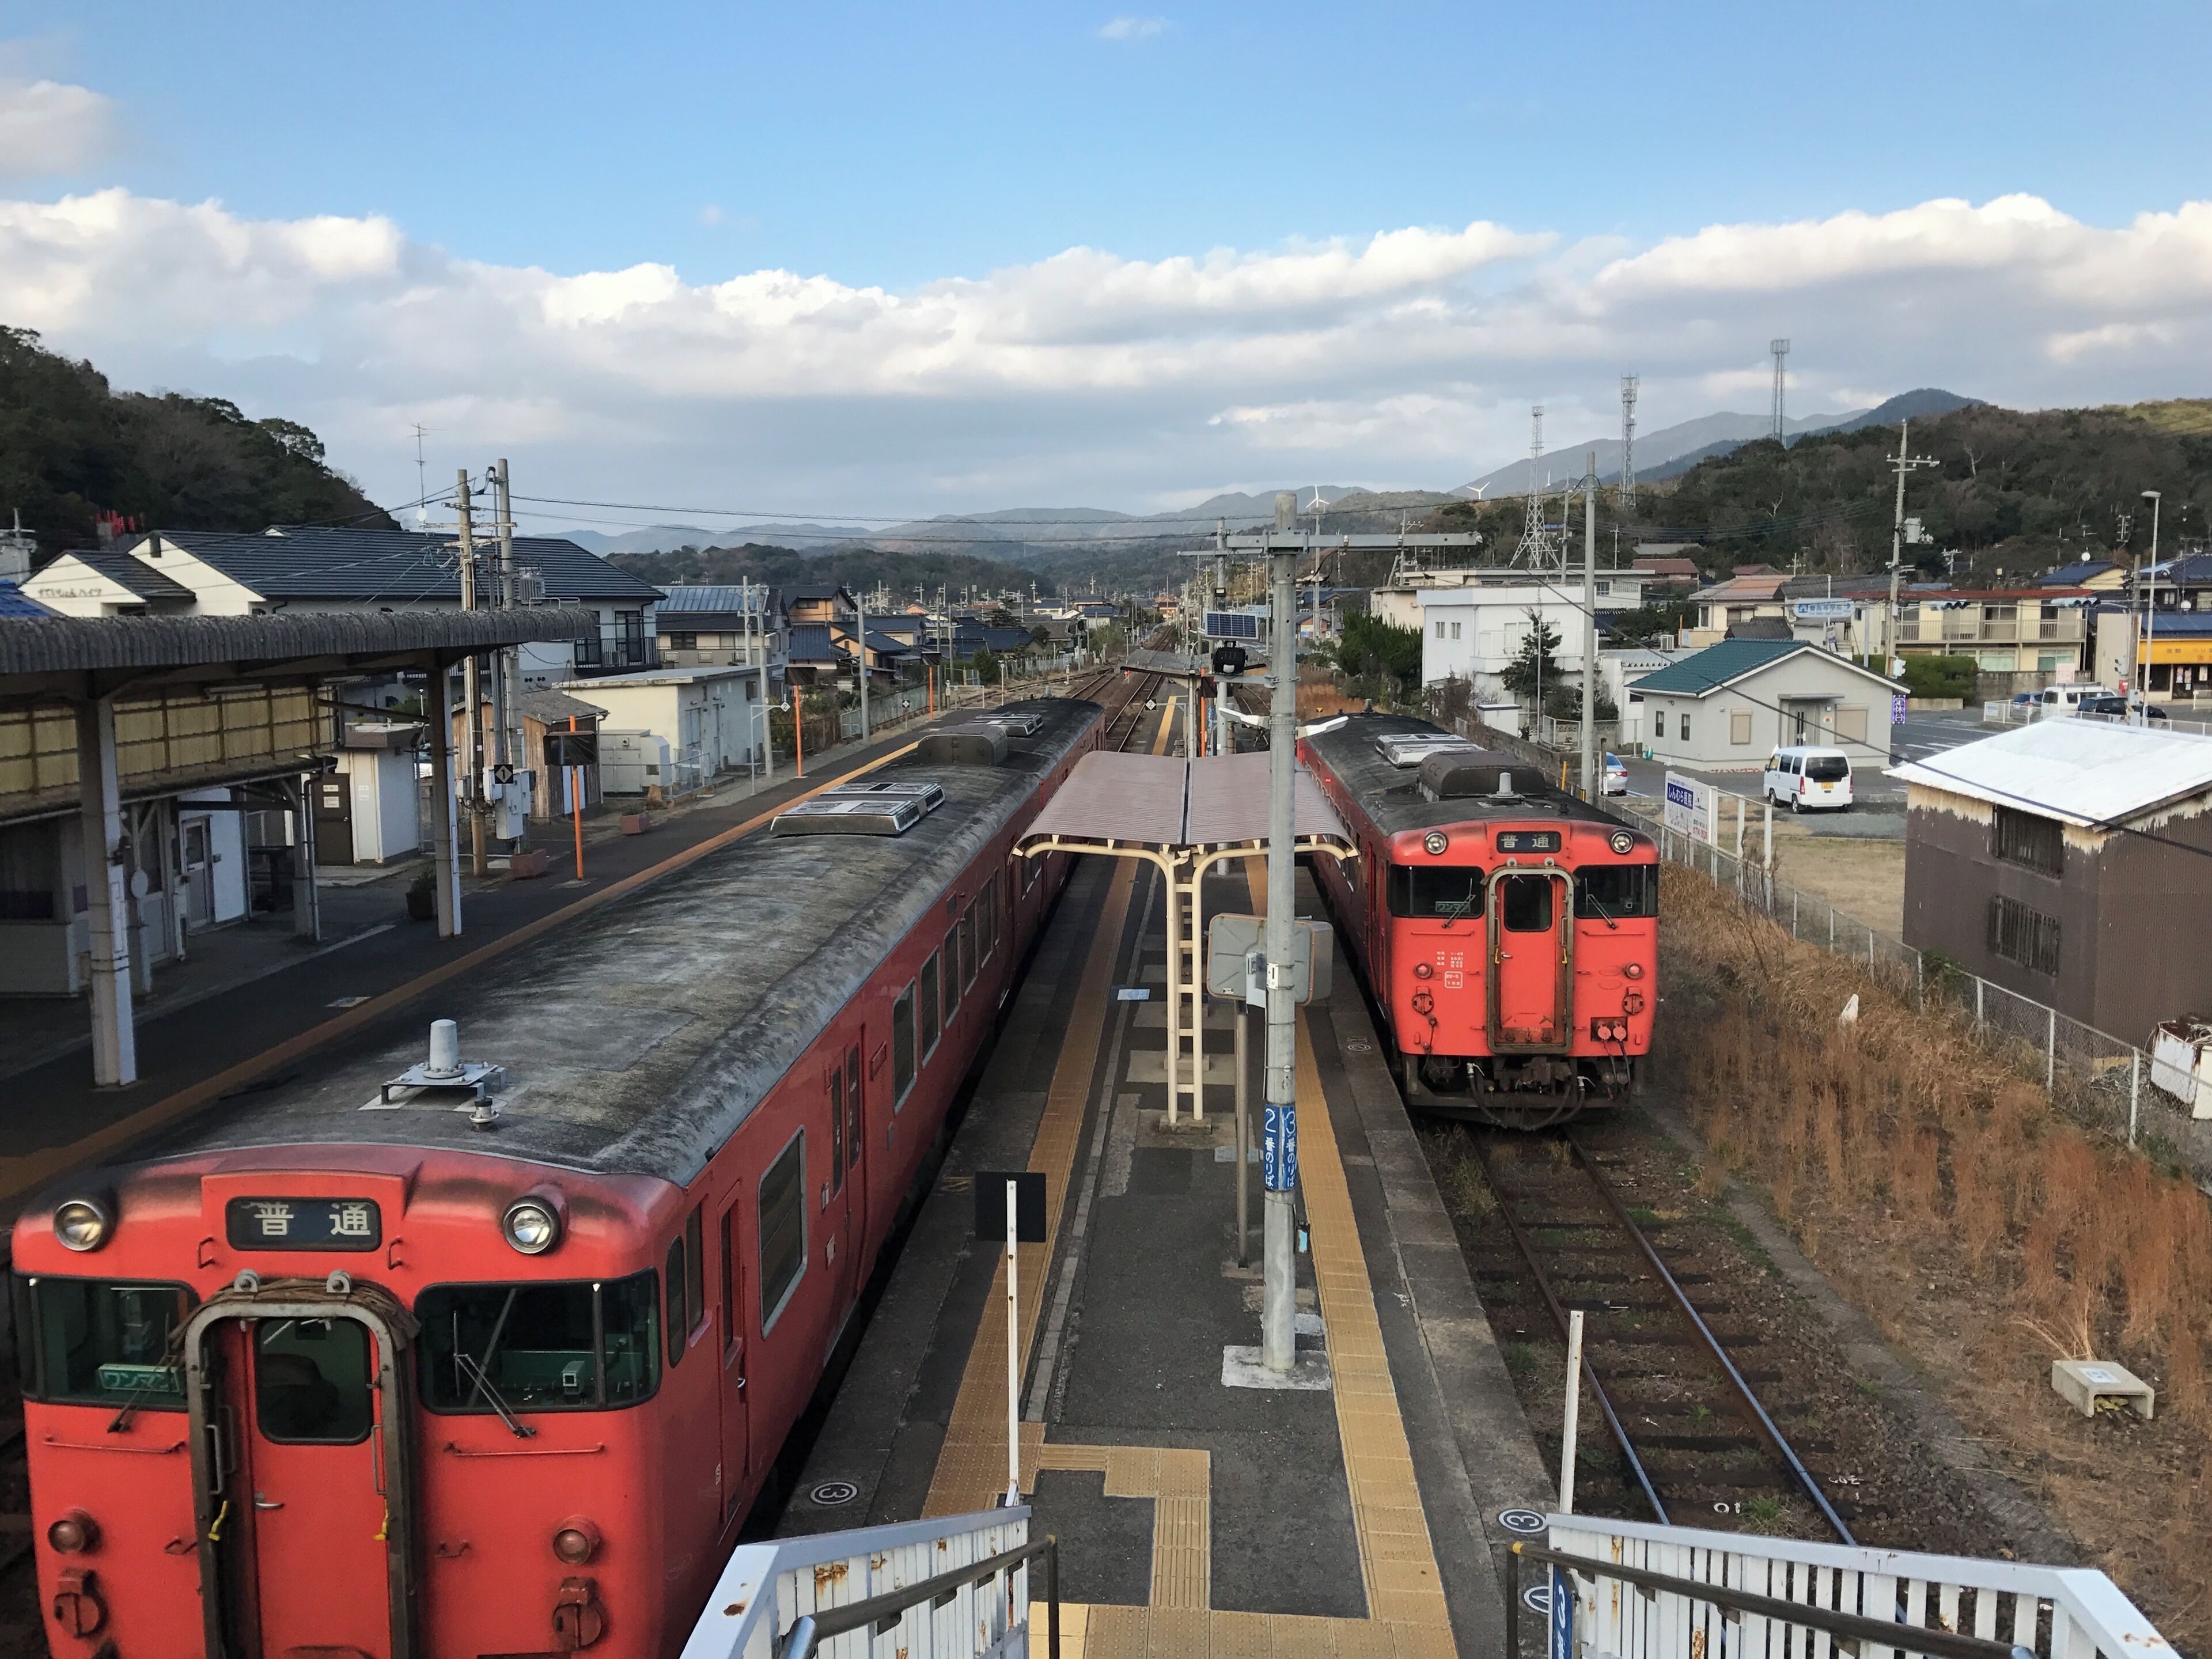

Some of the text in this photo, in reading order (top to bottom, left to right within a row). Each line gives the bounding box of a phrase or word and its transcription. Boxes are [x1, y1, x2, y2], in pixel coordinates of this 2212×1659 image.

[1668, 786, 1692, 808] しんむら医院
[1501, 833, 1550, 848] 普通
[253, 1202, 371, 1236] 普通
